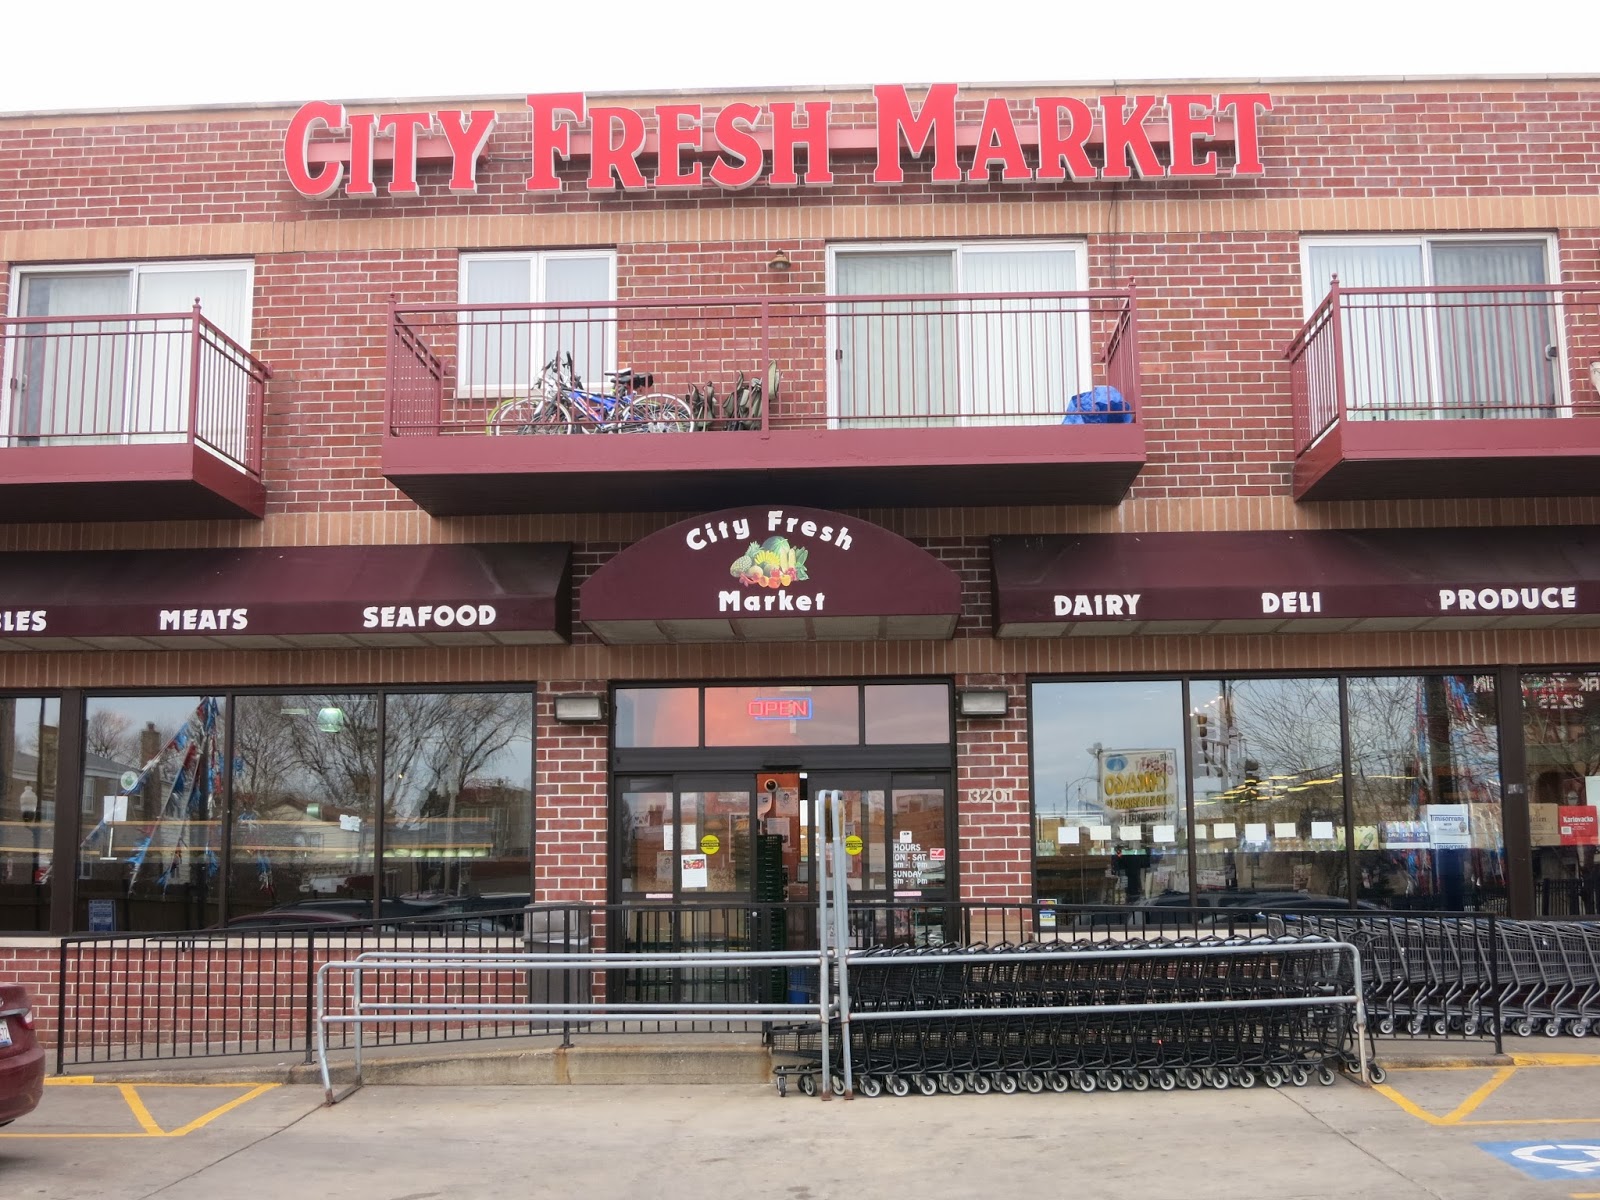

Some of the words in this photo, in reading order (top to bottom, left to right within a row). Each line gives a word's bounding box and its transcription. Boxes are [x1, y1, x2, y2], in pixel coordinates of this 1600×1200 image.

[284, 99, 498, 199] CITY
[525, 91, 833, 192] FRESH
[873, 83, 1275, 185] MARKET
[686, 518, 750, 550] City
[768, 510, 853, 550] Fresh
[718, 590, 826, 612] Market
[1054, 594, 1141, 616] DAIRY
[1261, 592, 1321, 613] DELI
[1439, 587, 1576, 610] PRODUCE
[160, 608, 248, 630] MEATS
[363, 605, 496, 628] SEAFOOD
[748, 700, 808, 716] OPEN
[968, 787, 1013, 803] 3201
[894, 843, 921, 851] HOURS
